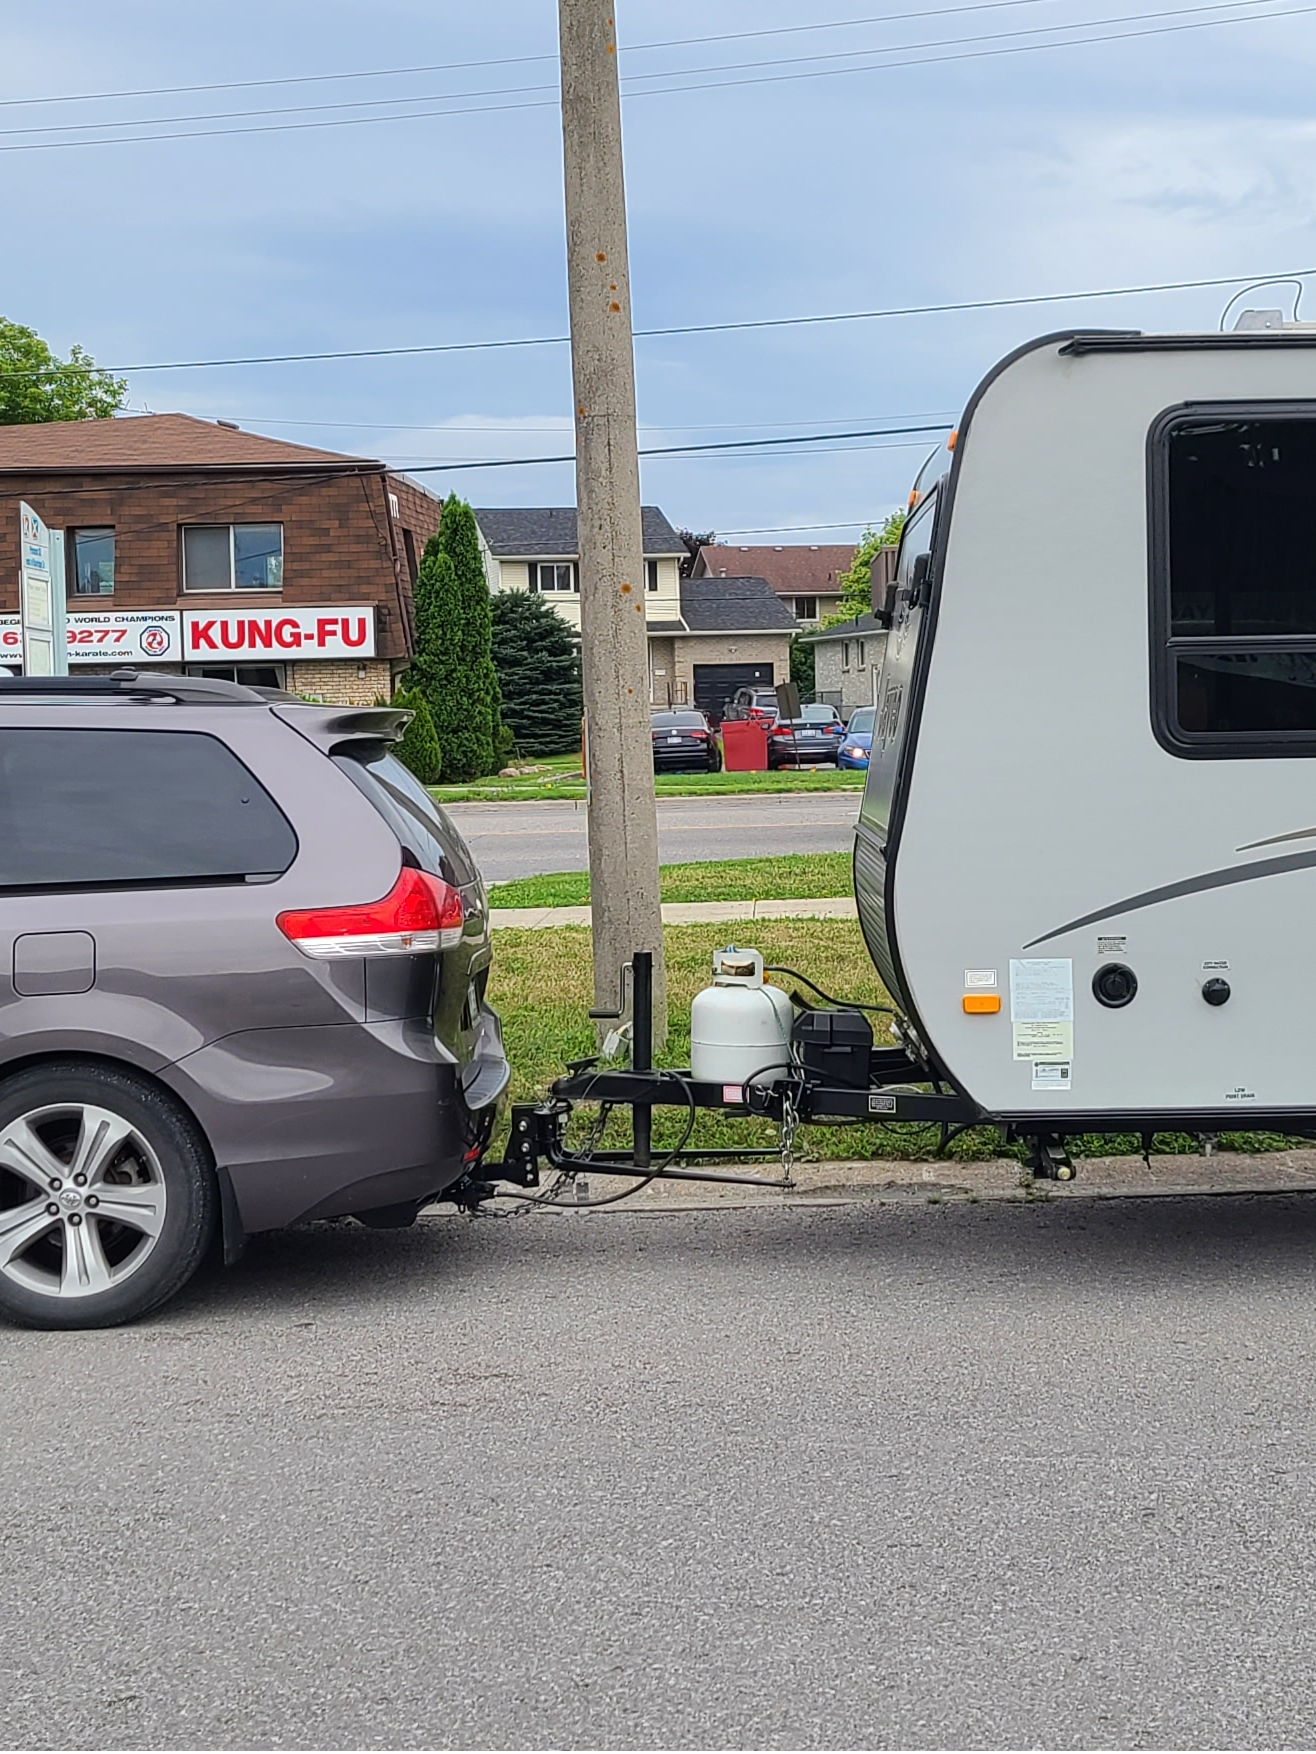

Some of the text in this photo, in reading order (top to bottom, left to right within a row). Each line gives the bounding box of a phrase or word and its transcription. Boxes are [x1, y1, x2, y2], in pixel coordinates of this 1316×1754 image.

[74, 616, 110, 624] WORLD
[115, 615, 175, 623] CHAMPIONS
[190, 617, 367, 650] KUNG-FU
